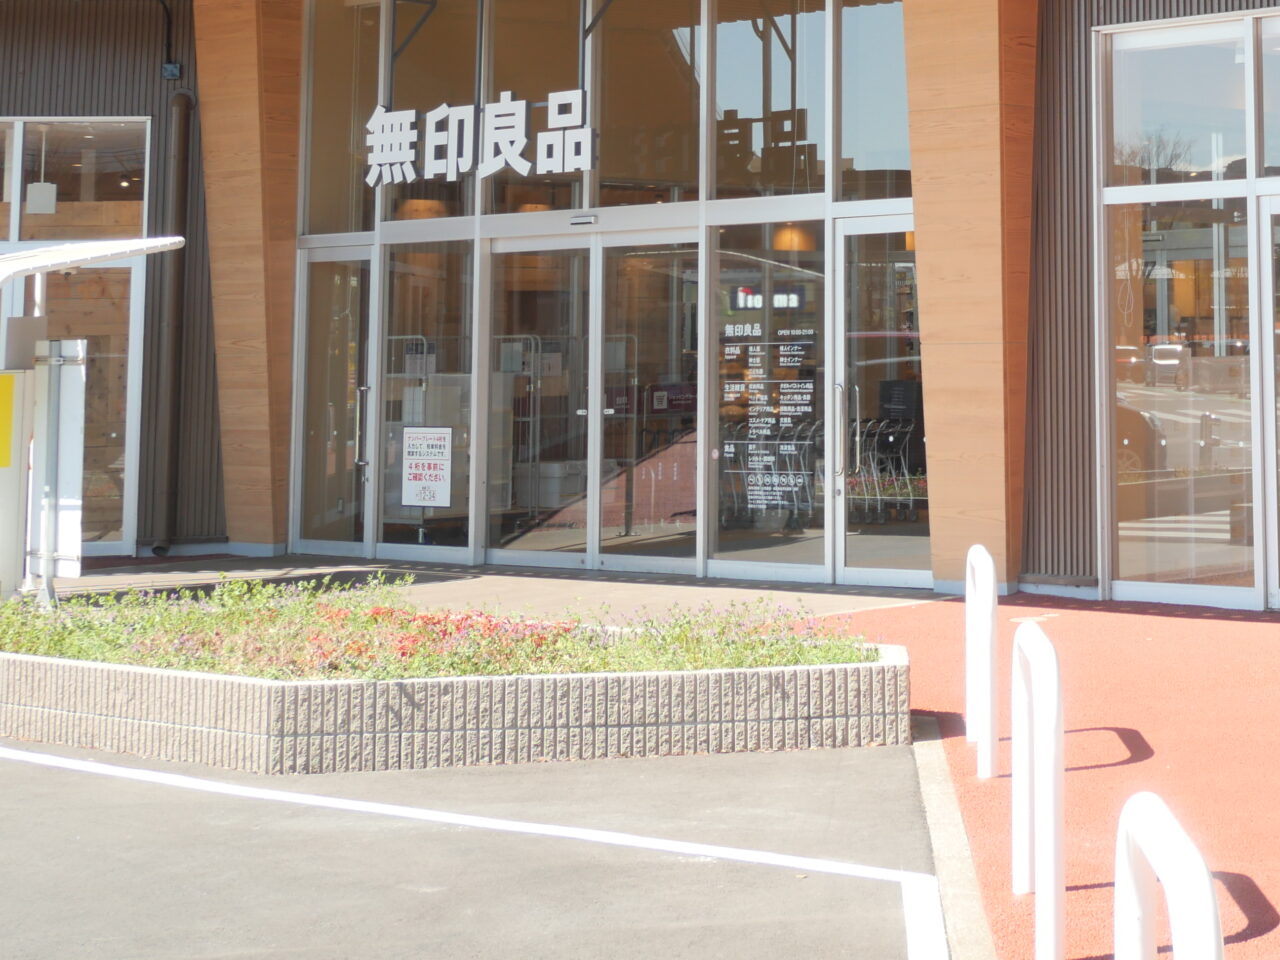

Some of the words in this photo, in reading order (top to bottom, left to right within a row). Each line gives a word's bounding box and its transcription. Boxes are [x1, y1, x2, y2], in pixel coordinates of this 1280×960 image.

[365, 90, 594, 187] 無印良品
[724, 323, 762, 336] 無印良品
